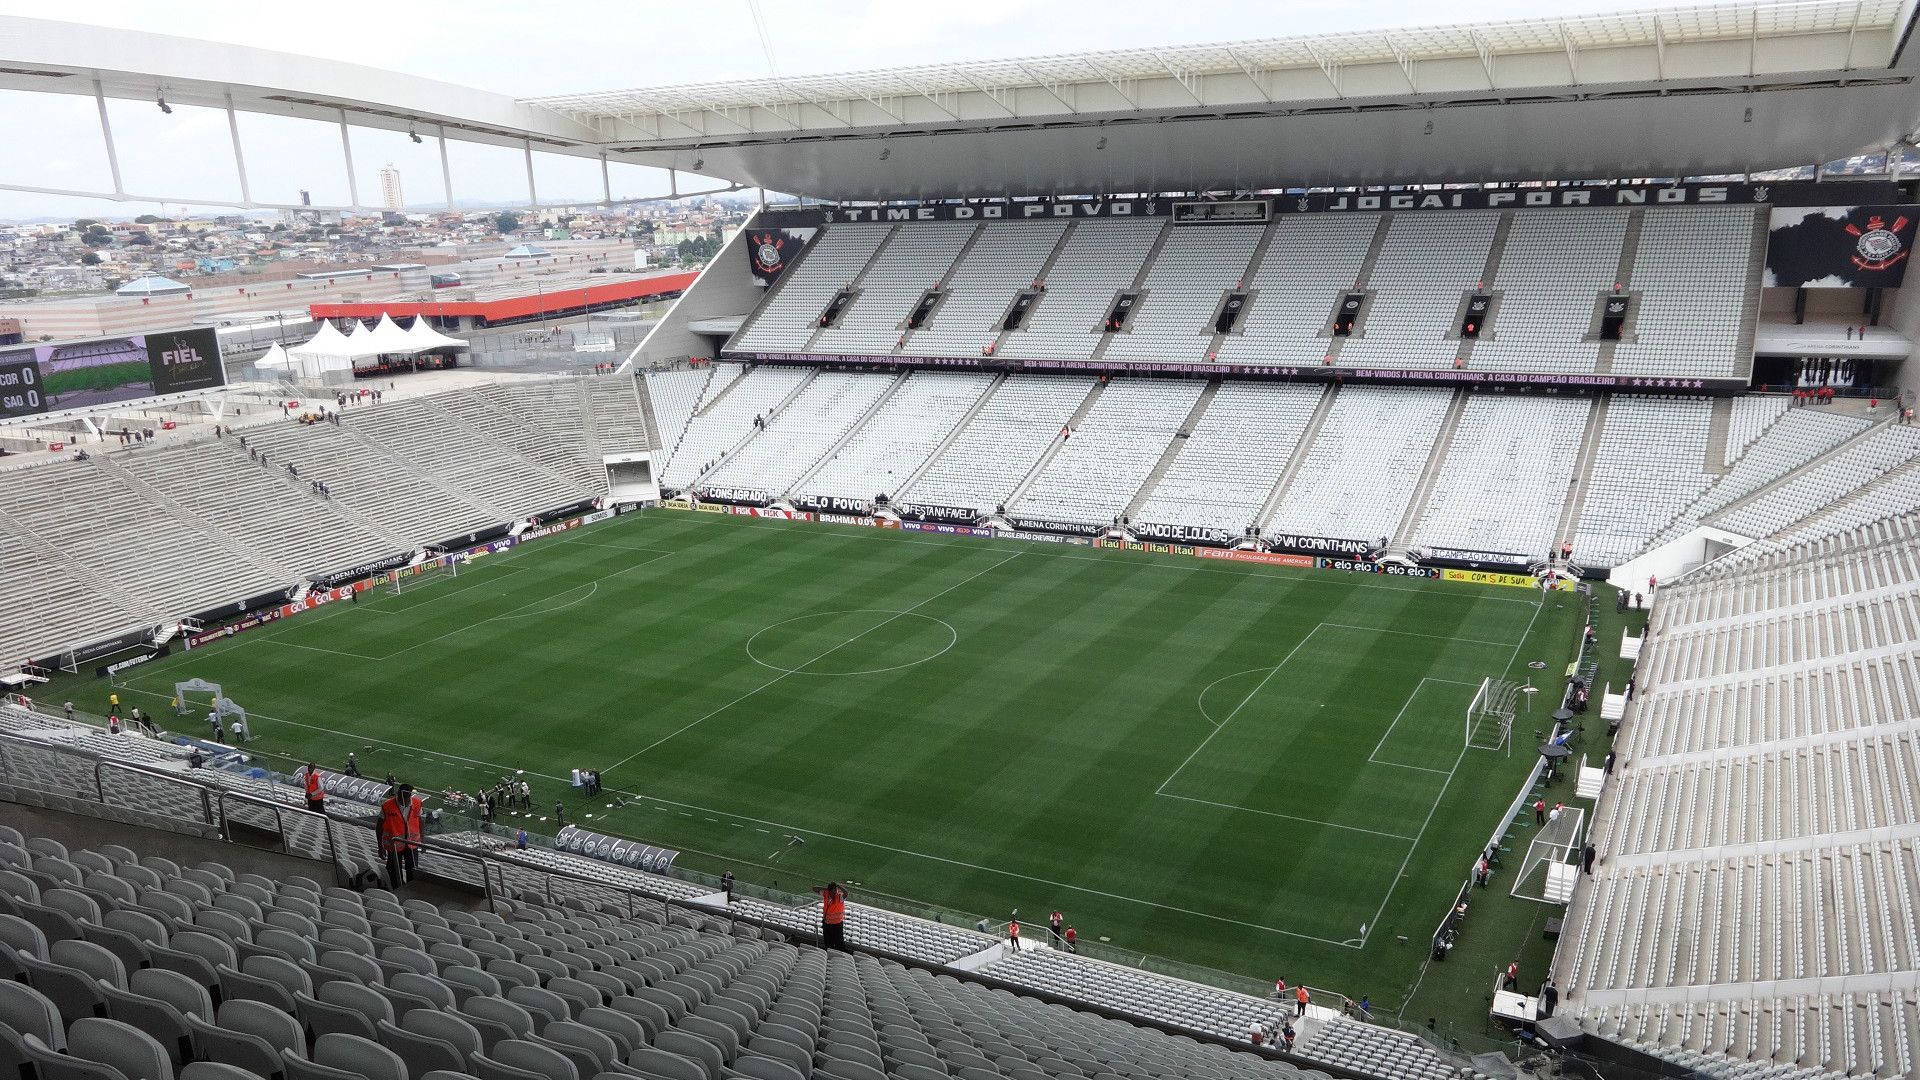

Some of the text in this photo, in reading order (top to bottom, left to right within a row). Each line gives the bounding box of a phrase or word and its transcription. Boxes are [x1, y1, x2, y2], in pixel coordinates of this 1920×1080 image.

[1329, 193, 1462, 210] JOGAI
[1489, 191, 1591, 206] POR
[845, 202, 1132, 221] TIME DO POVO
[162, 348, 202, 366] FIEL
[0, 368, 34, 386] COR 0
[1356, 370, 1401, 378] BEM-VINDOS
[1408, 371, 1433, 379] ARENA
[1529, 374, 1567, 384] CAMPEÃO
[1568, 376, 1616, 385] BRASILEIRO
[28, 390, 39, 407] 0
[710, 488, 766, 501] CONSAGRADO
[800, 495, 862, 510] PELO POVO
[820, 514, 856, 525] BRAHMA
[946, 507, 976, 520] FAVELA
[1019, 520, 1096, 533] ARENA CORINTHIANS
[1140, 524, 1171, 537] BANDO
[1172, 525, 1184, 538] DE
[521, 527, 551, 542] BRAHMA
[1032, 534, 1064, 543] CHEVROLET
[1282, 535, 1368, 553] VAI CORINTHIANS
[1481, 554, 1518, 563] MUNDIAL
[330, 556, 403, 583] ARENA CORINTHIANS
[1335, 561, 1351, 570] elo
[1354, 562, 1371, 571] elo
[1387, 566, 1404, 574] elo
[1407, 567, 1425, 576] elo
[1449, 571, 1464, 580] Sadia
[1472, 573, 1486, 582] COM
[1490, 574, 1496, 583] S
[316, 592, 334, 604] GOL
[291, 602, 309, 613] GOL
